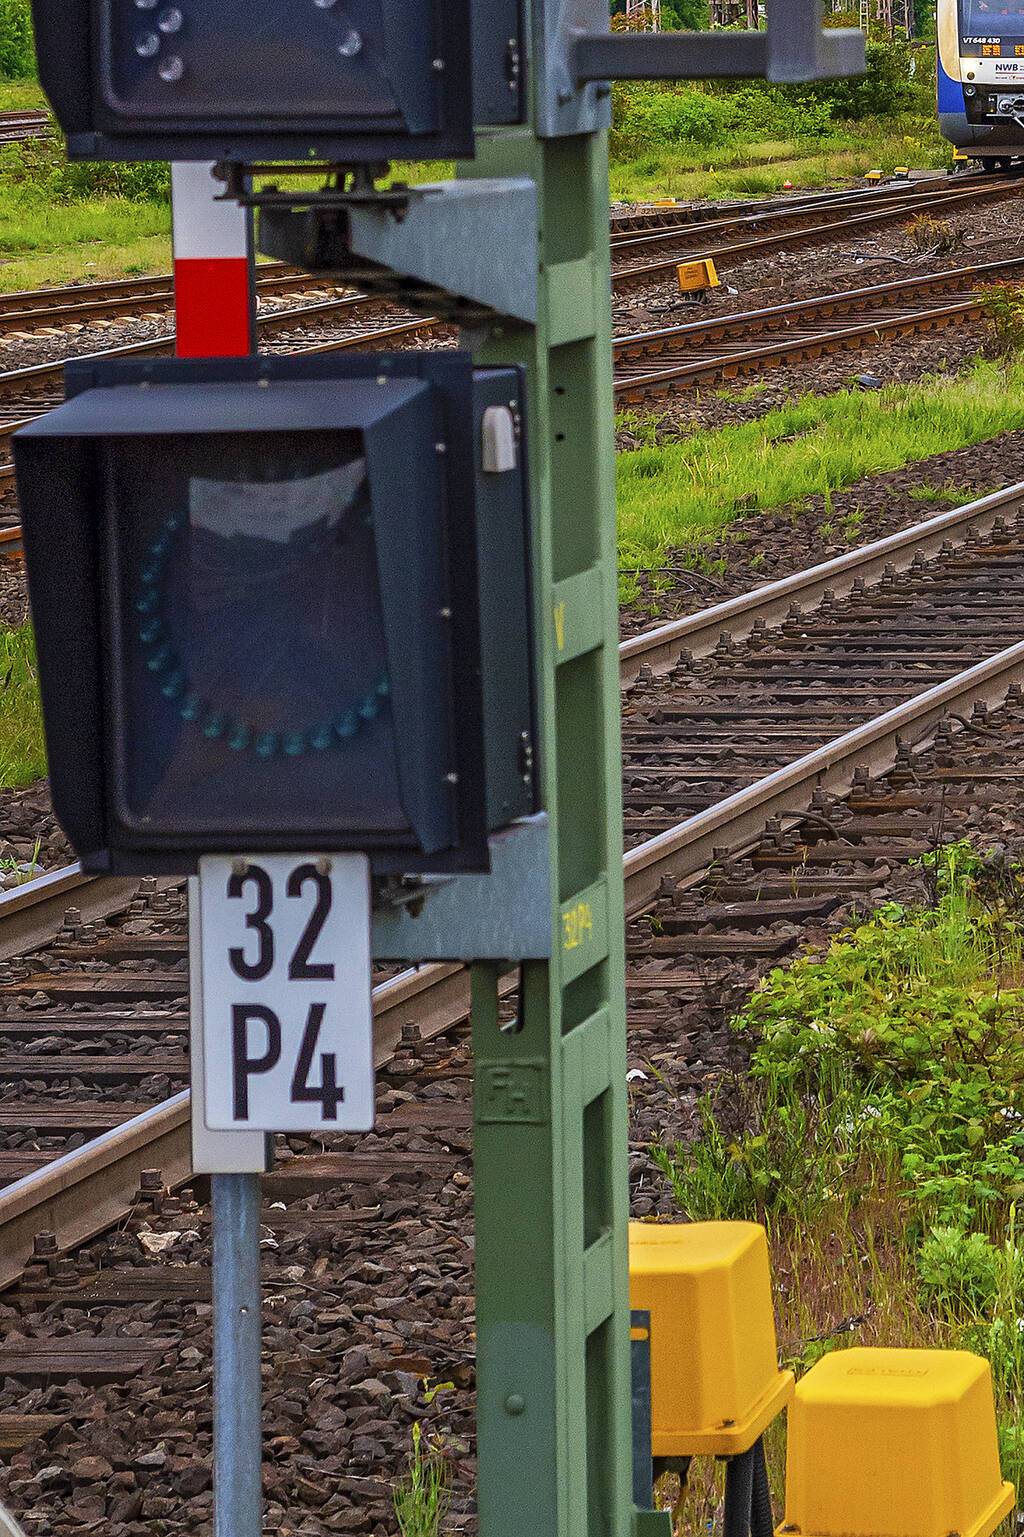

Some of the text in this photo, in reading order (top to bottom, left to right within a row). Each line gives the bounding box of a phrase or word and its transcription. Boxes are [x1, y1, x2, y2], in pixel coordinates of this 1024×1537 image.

[995, 64, 1018, 72] NWB
[226, 863, 335, 981] 32
[231, 1003, 345, 1122] P4
